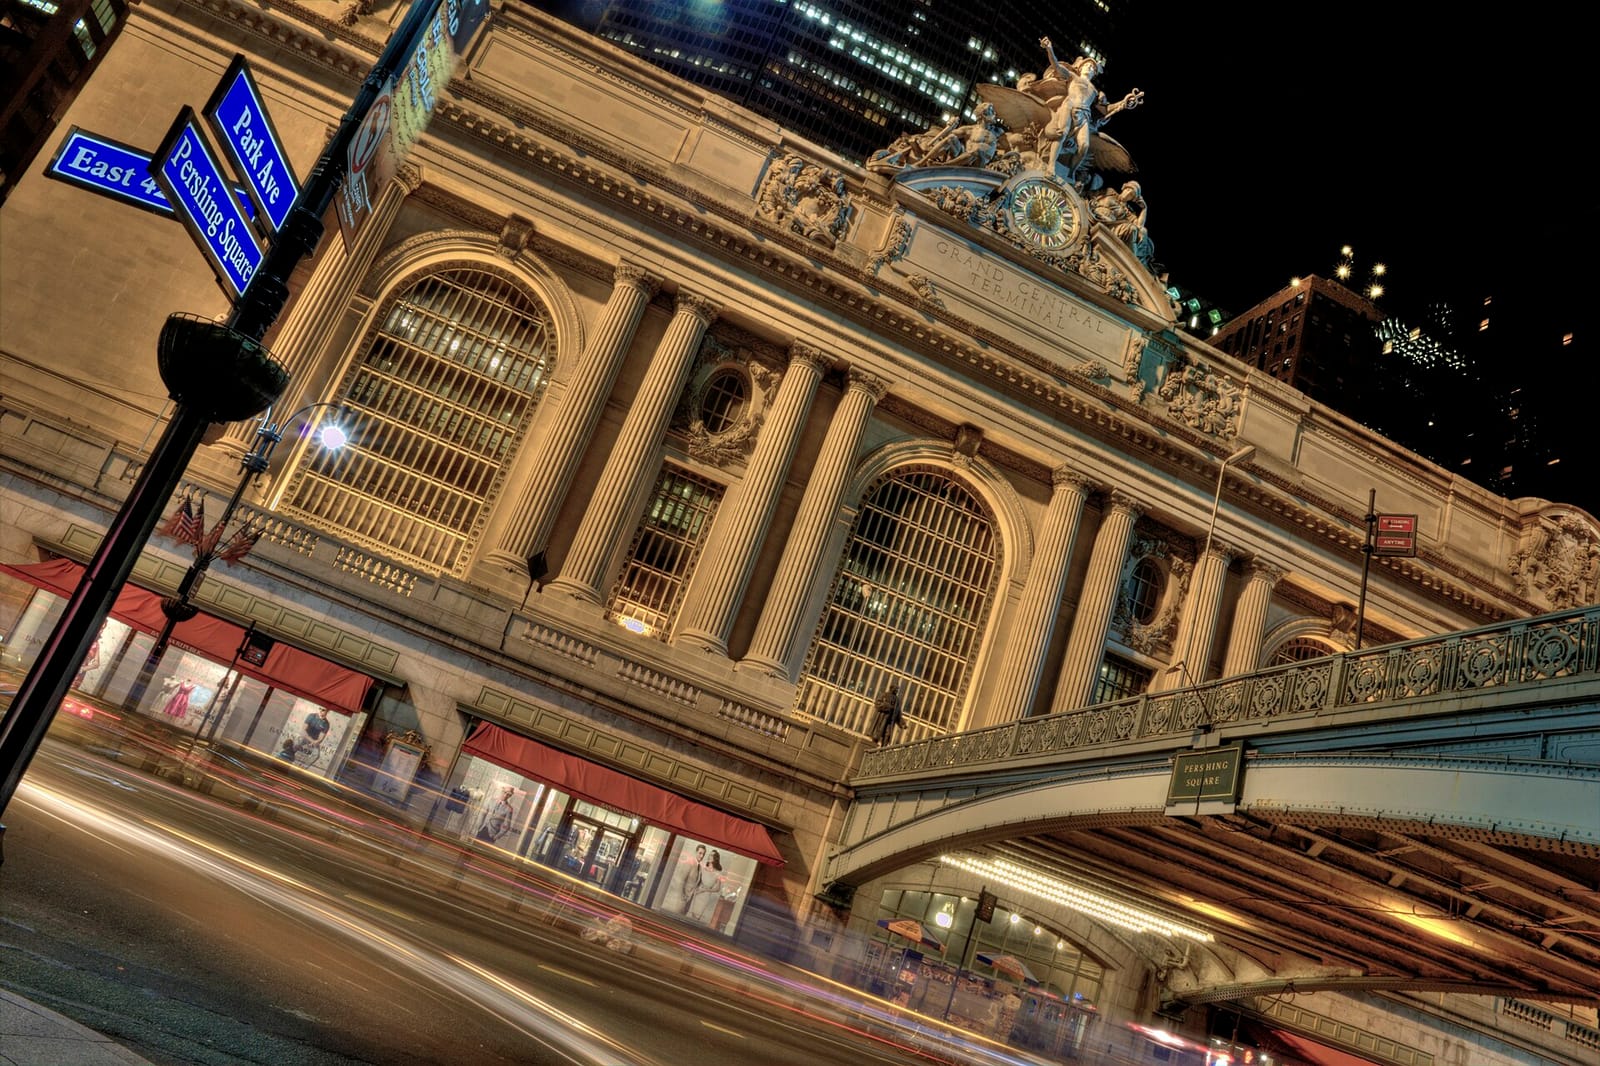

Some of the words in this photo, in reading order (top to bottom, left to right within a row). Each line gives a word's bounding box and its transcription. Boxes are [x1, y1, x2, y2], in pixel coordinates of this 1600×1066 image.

[67, 146, 137, 188] East
[232, 104, 265, 170] Park
[256, 159, 280, 205] Ave
[170, 135, 225, 238] Pershing
[218, 218, 253, 283] Square
[936, 241, 1005, 283] GRAND
[1018, 282, 1104, 335] CENTRAL
[970, 271, 1065, 331] TERMINAL
[1184, 761, 1229, 773] PERSHING
[1186, 776, 1220, 787] SQUARE
